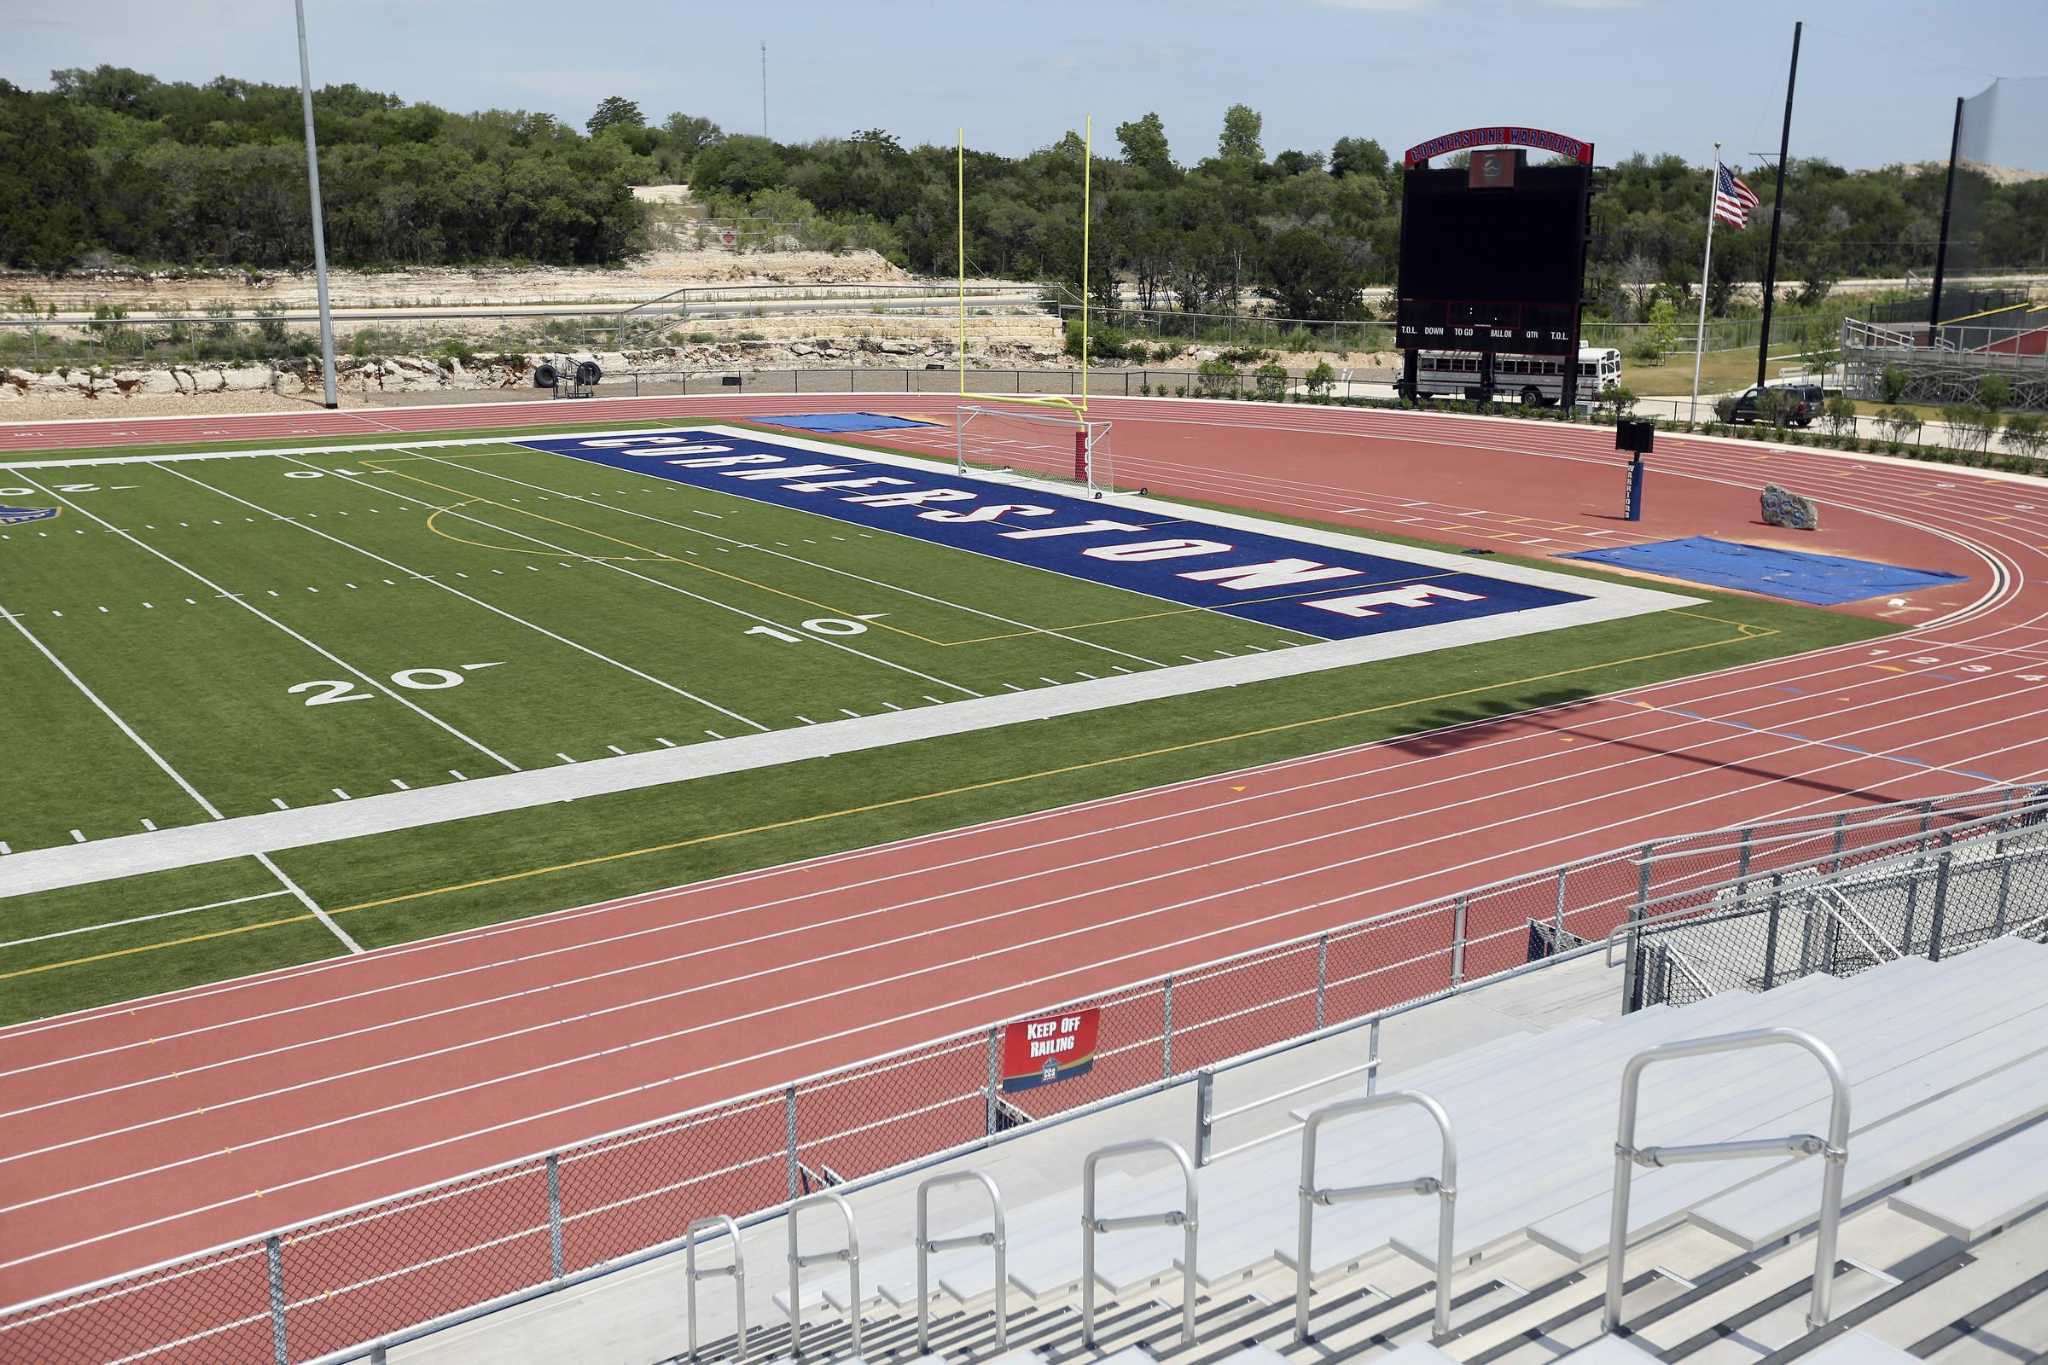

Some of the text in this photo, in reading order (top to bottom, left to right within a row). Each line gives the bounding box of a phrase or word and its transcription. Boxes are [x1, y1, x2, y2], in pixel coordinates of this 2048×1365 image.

[1411, 128, 1581, 161] CORNERSTONE WARRIORS
[1424, 327, 1443, 335] DOWN
[580, 435, 1485, 617] CORNERSTONE
[1027, 1016, 1081, 1040] KEEP OFF
[1030, 1036, 1074, 1058] RAILING
